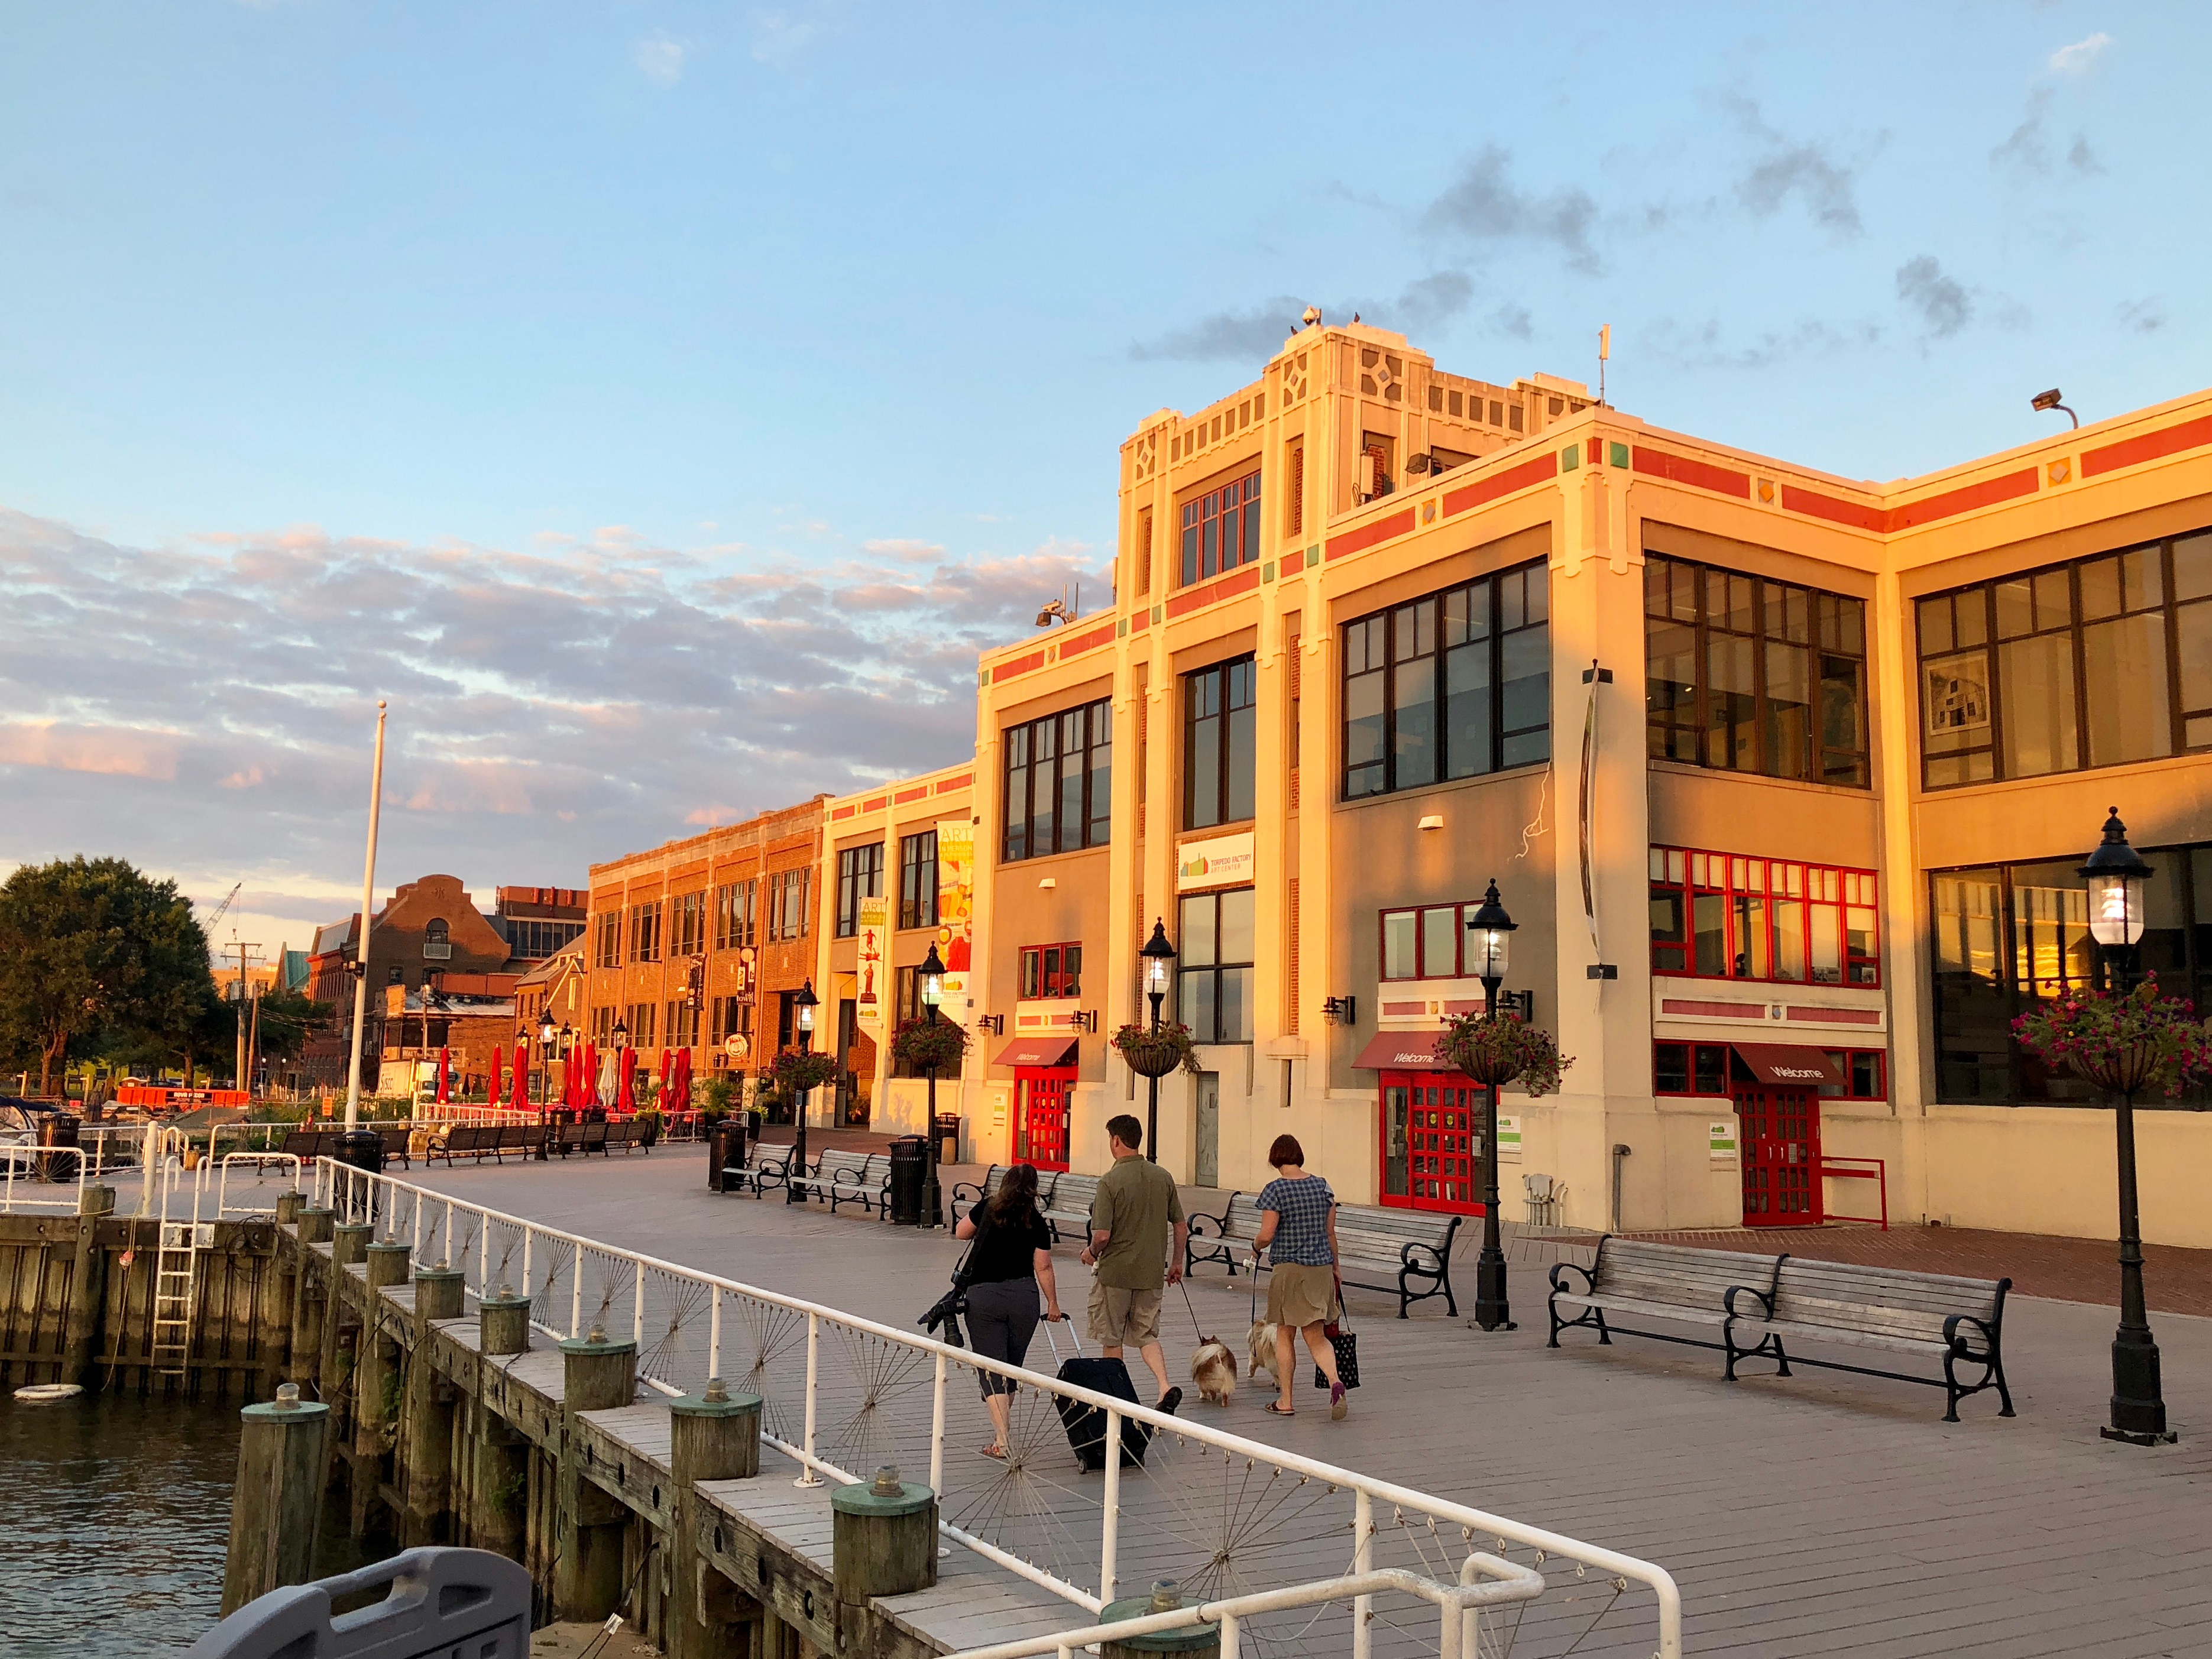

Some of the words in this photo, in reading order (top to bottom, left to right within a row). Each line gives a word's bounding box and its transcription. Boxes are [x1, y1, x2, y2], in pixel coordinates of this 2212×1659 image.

[941, 828, 972, 842] ART
[1211, 857, 1230, 866] TORPEDO
[1232, 853, 1252, 863] FACTORY
[1221, 863, 1241, 872] CENTER
[863, 902, 885, 913] ART
[1394, 1052, 1436, 1063] Welcome
[1770, 1067, 1824, 1078] Welcome
